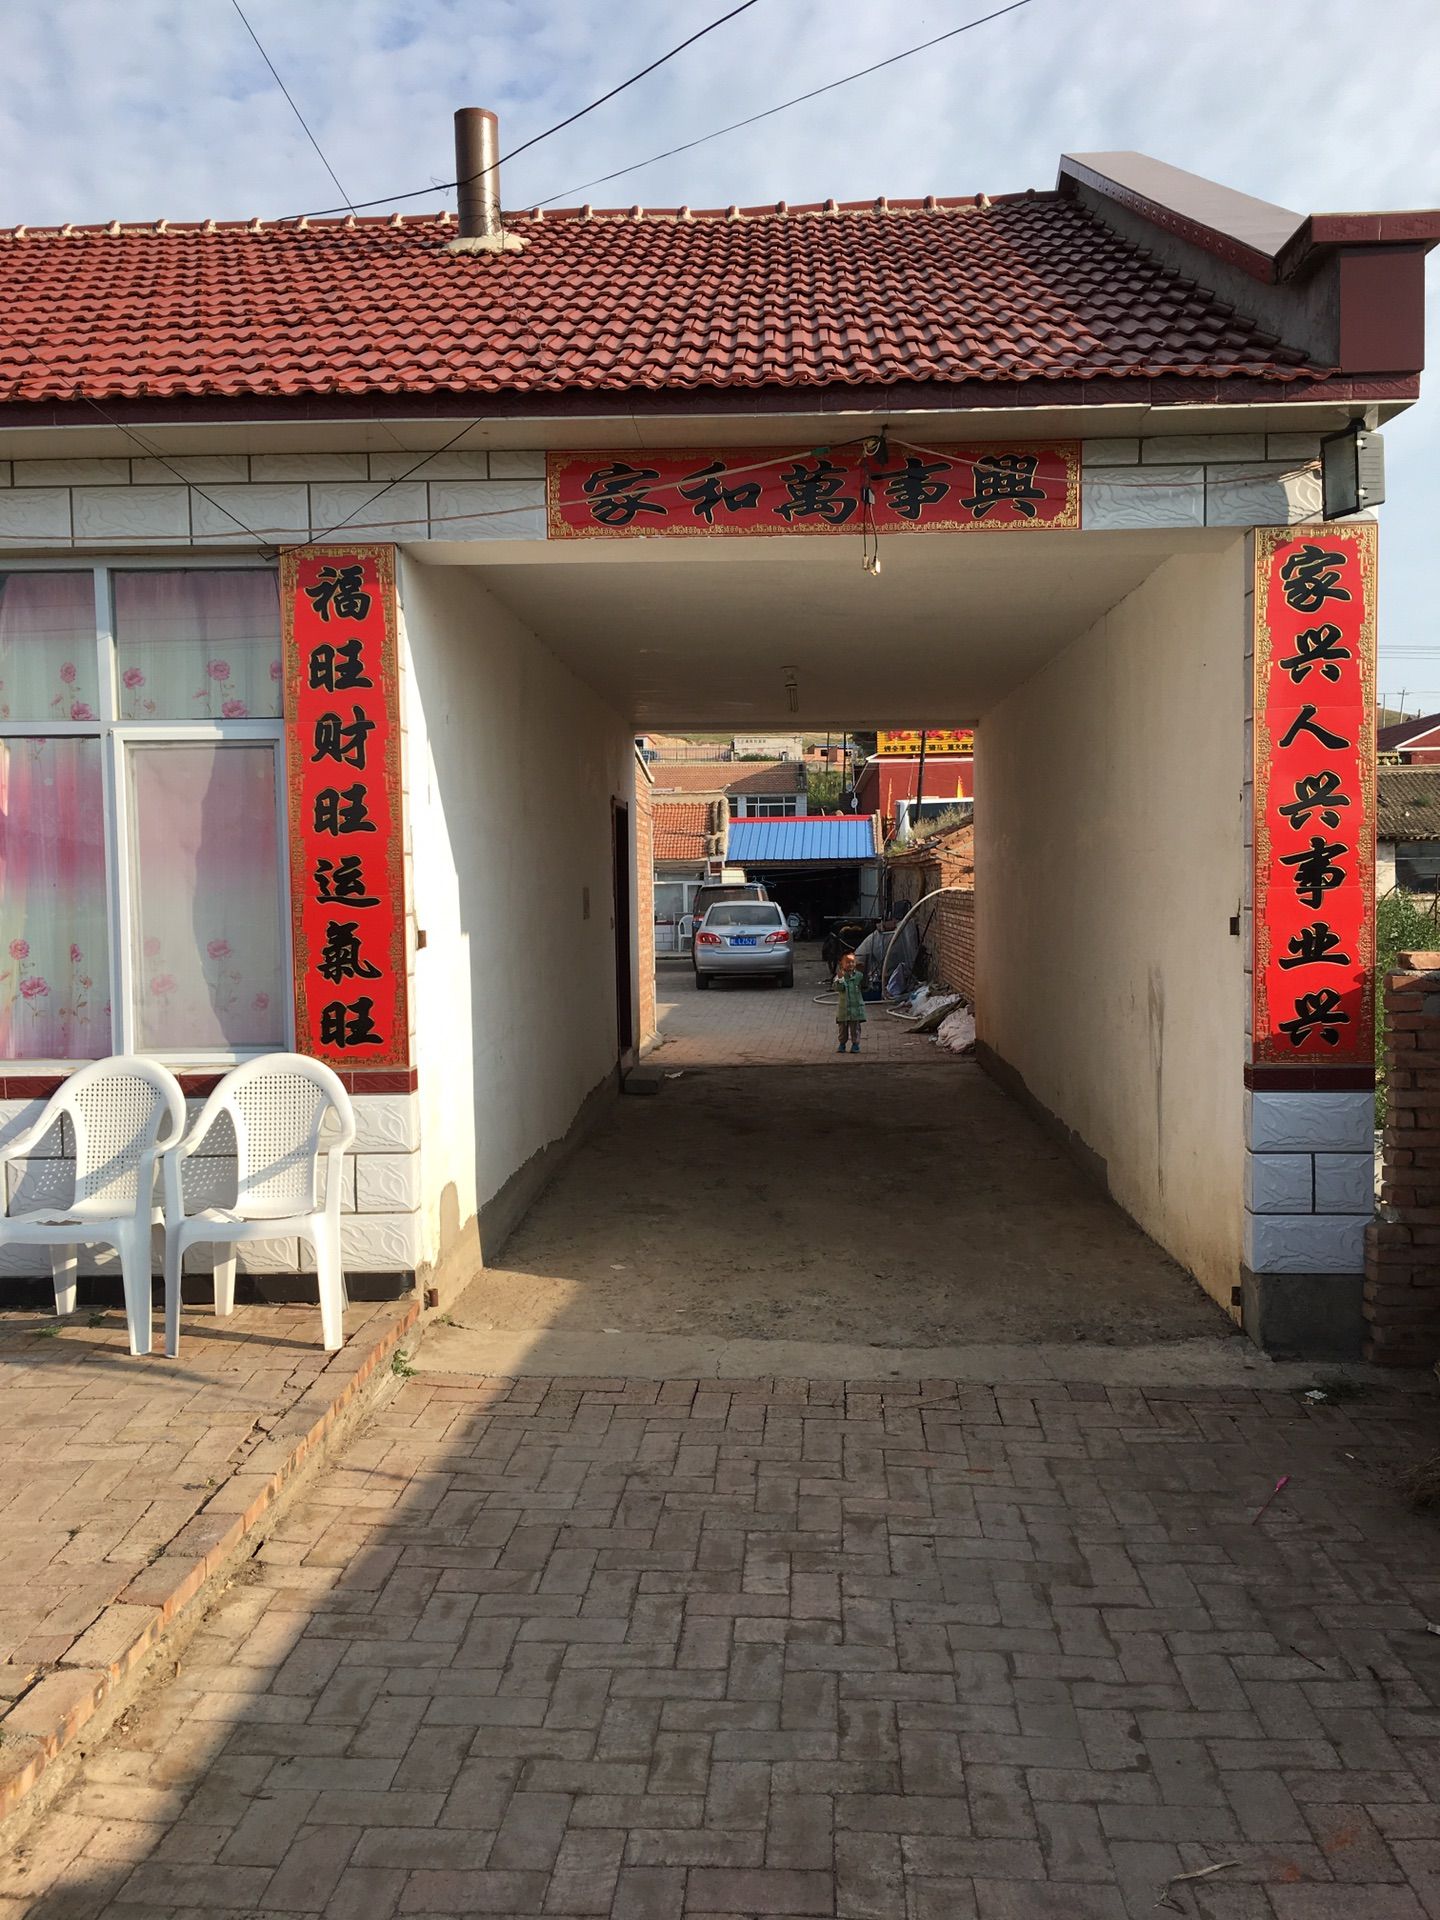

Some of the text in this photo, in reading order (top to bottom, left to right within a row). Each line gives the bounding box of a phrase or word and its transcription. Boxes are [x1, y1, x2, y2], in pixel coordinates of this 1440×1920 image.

[582, 454, 1047, 525] 家和萬事興
[1277, 544, 1353, 1049] 家兴人兴事业兴
